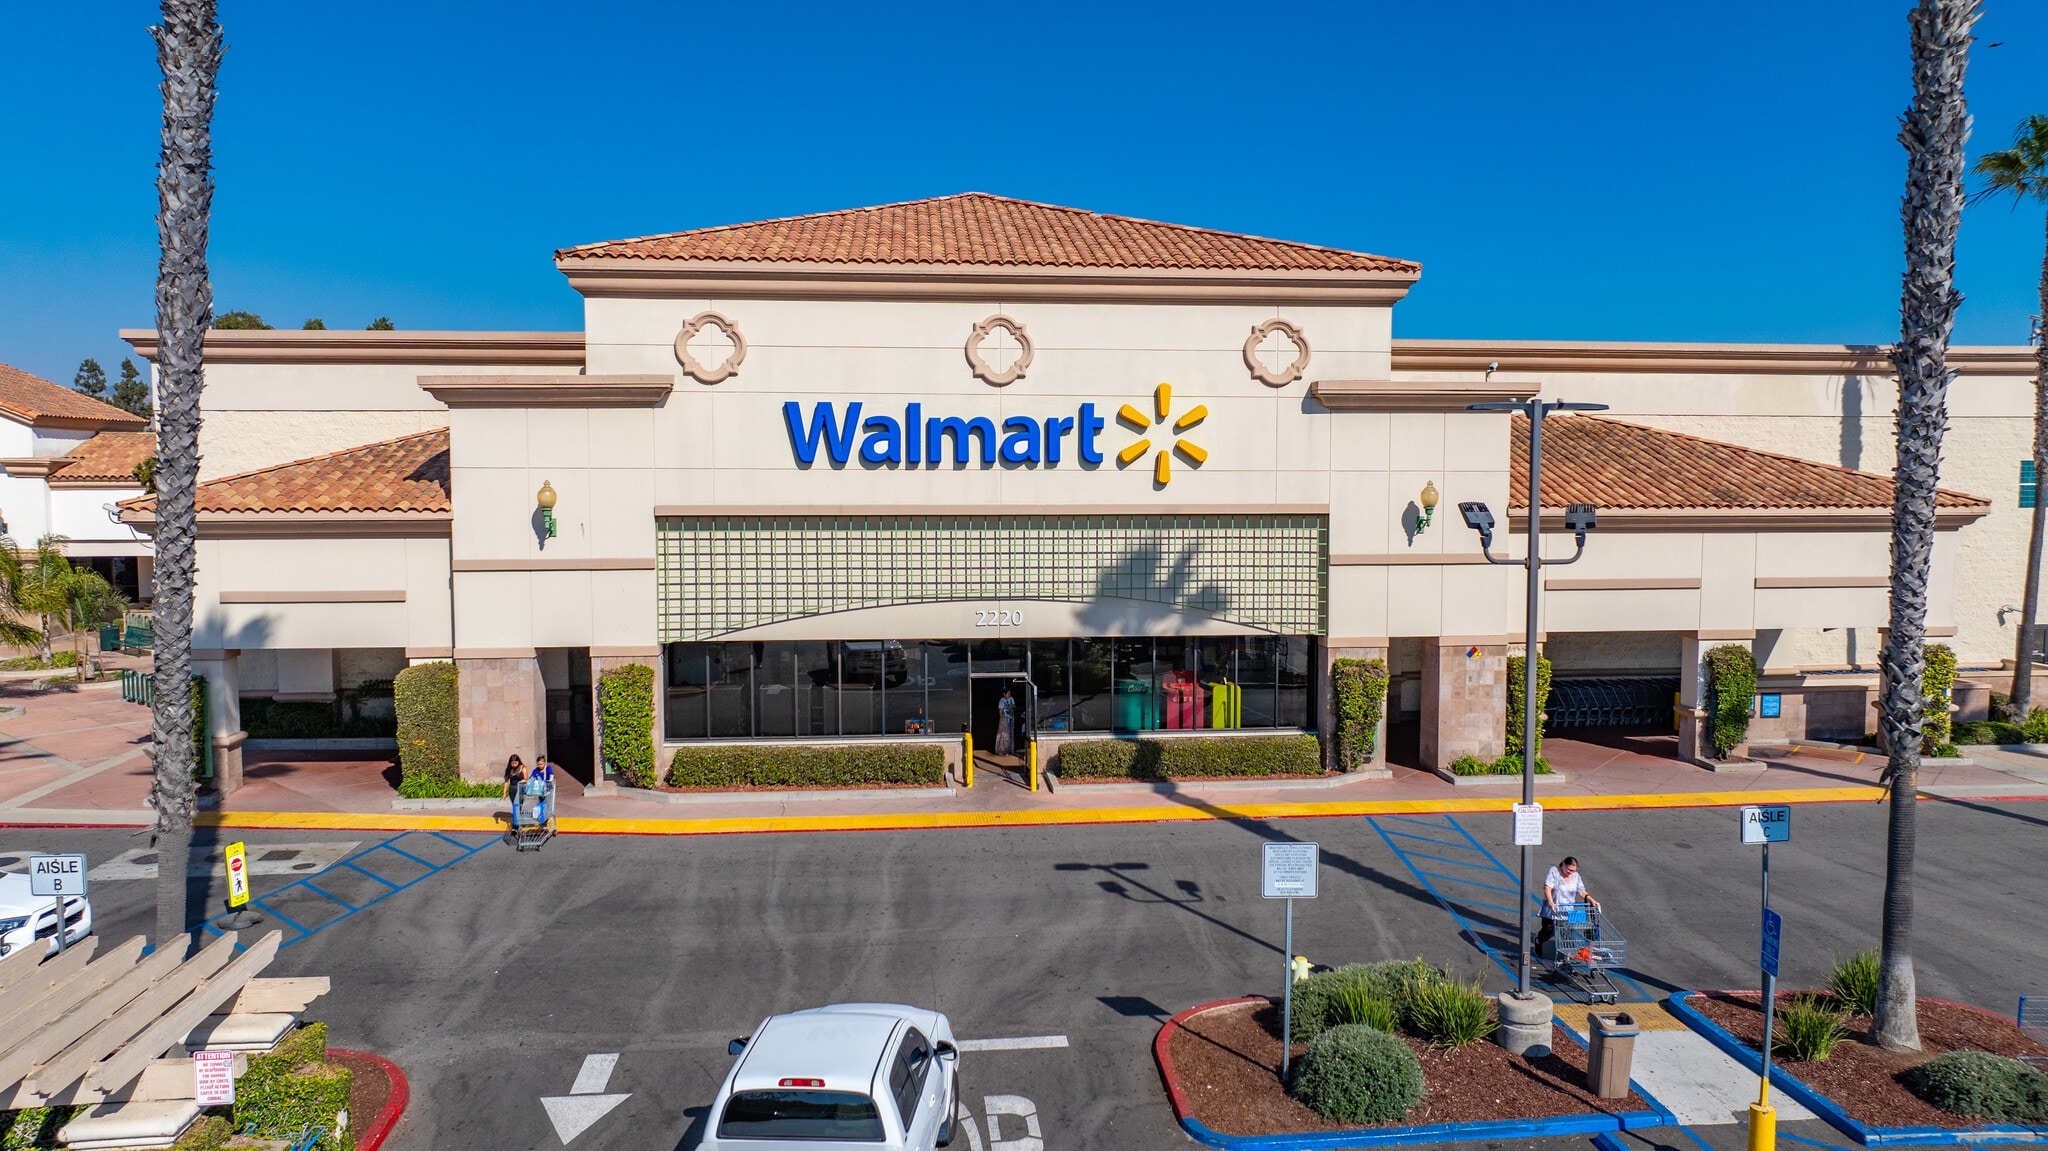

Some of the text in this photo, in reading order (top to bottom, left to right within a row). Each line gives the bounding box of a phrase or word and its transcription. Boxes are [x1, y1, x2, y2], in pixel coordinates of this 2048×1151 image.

[783, 401, 1105, 463] Walmart
[976, 610, 1023, 626] 2220
[1749, 811, 1785, 823] AISLE
[1763, 826, 1770, 838] C
[37, 861, 79, 873] AISLE
[54, 878, 63, 891] B
[196, 1052, 231, 1060] ATTENTION
